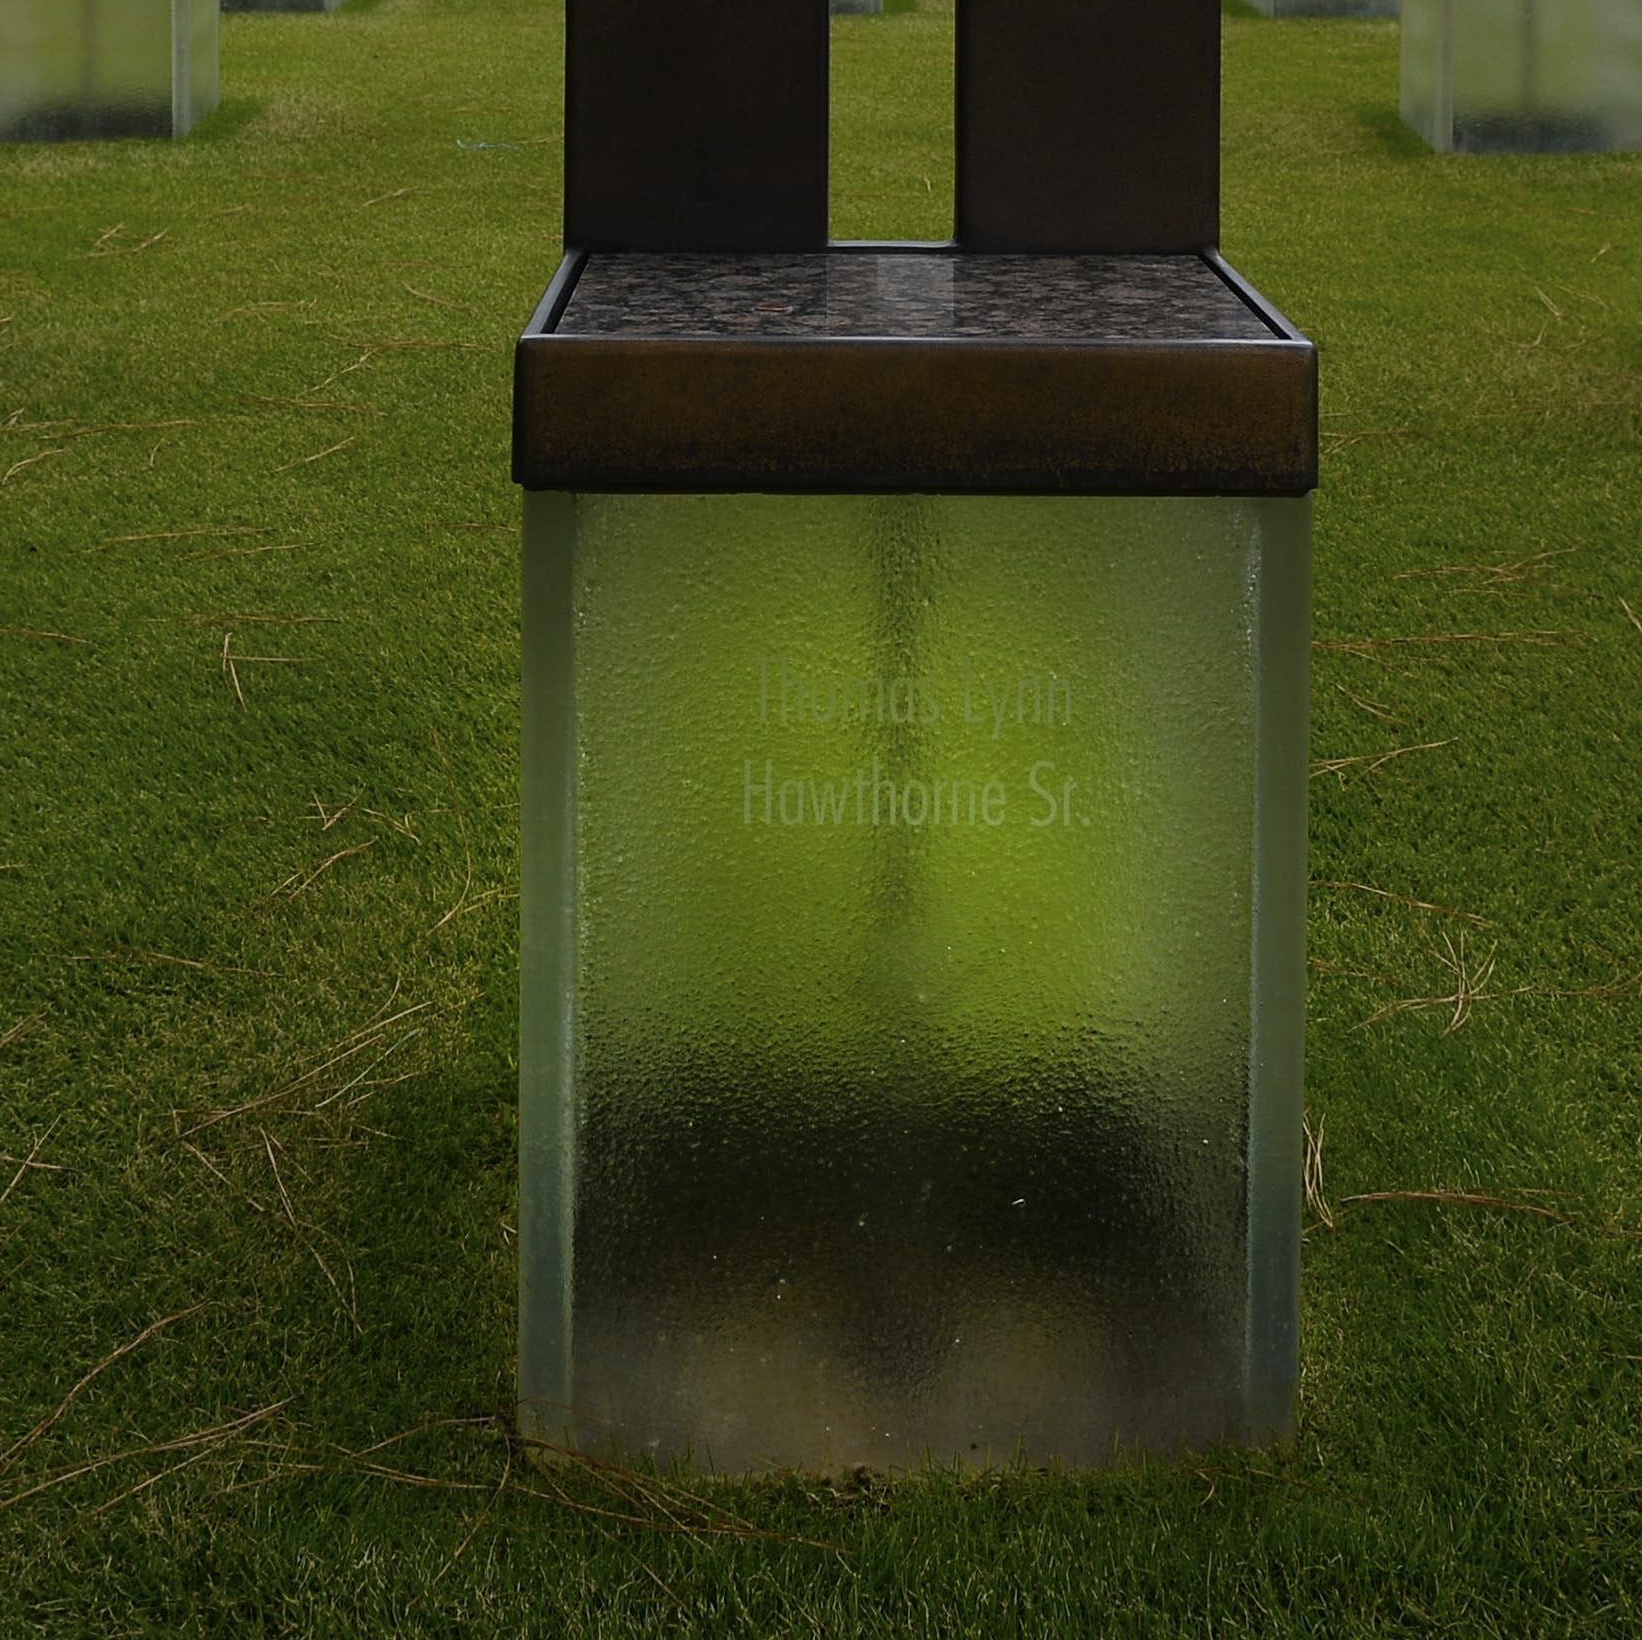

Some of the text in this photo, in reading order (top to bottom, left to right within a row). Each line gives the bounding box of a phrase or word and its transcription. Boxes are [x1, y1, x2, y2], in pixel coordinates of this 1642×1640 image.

[755, 659, 1074, 741] Thomas Lynn
[743, 760, 1091, 827] Hawthorne Sr.
